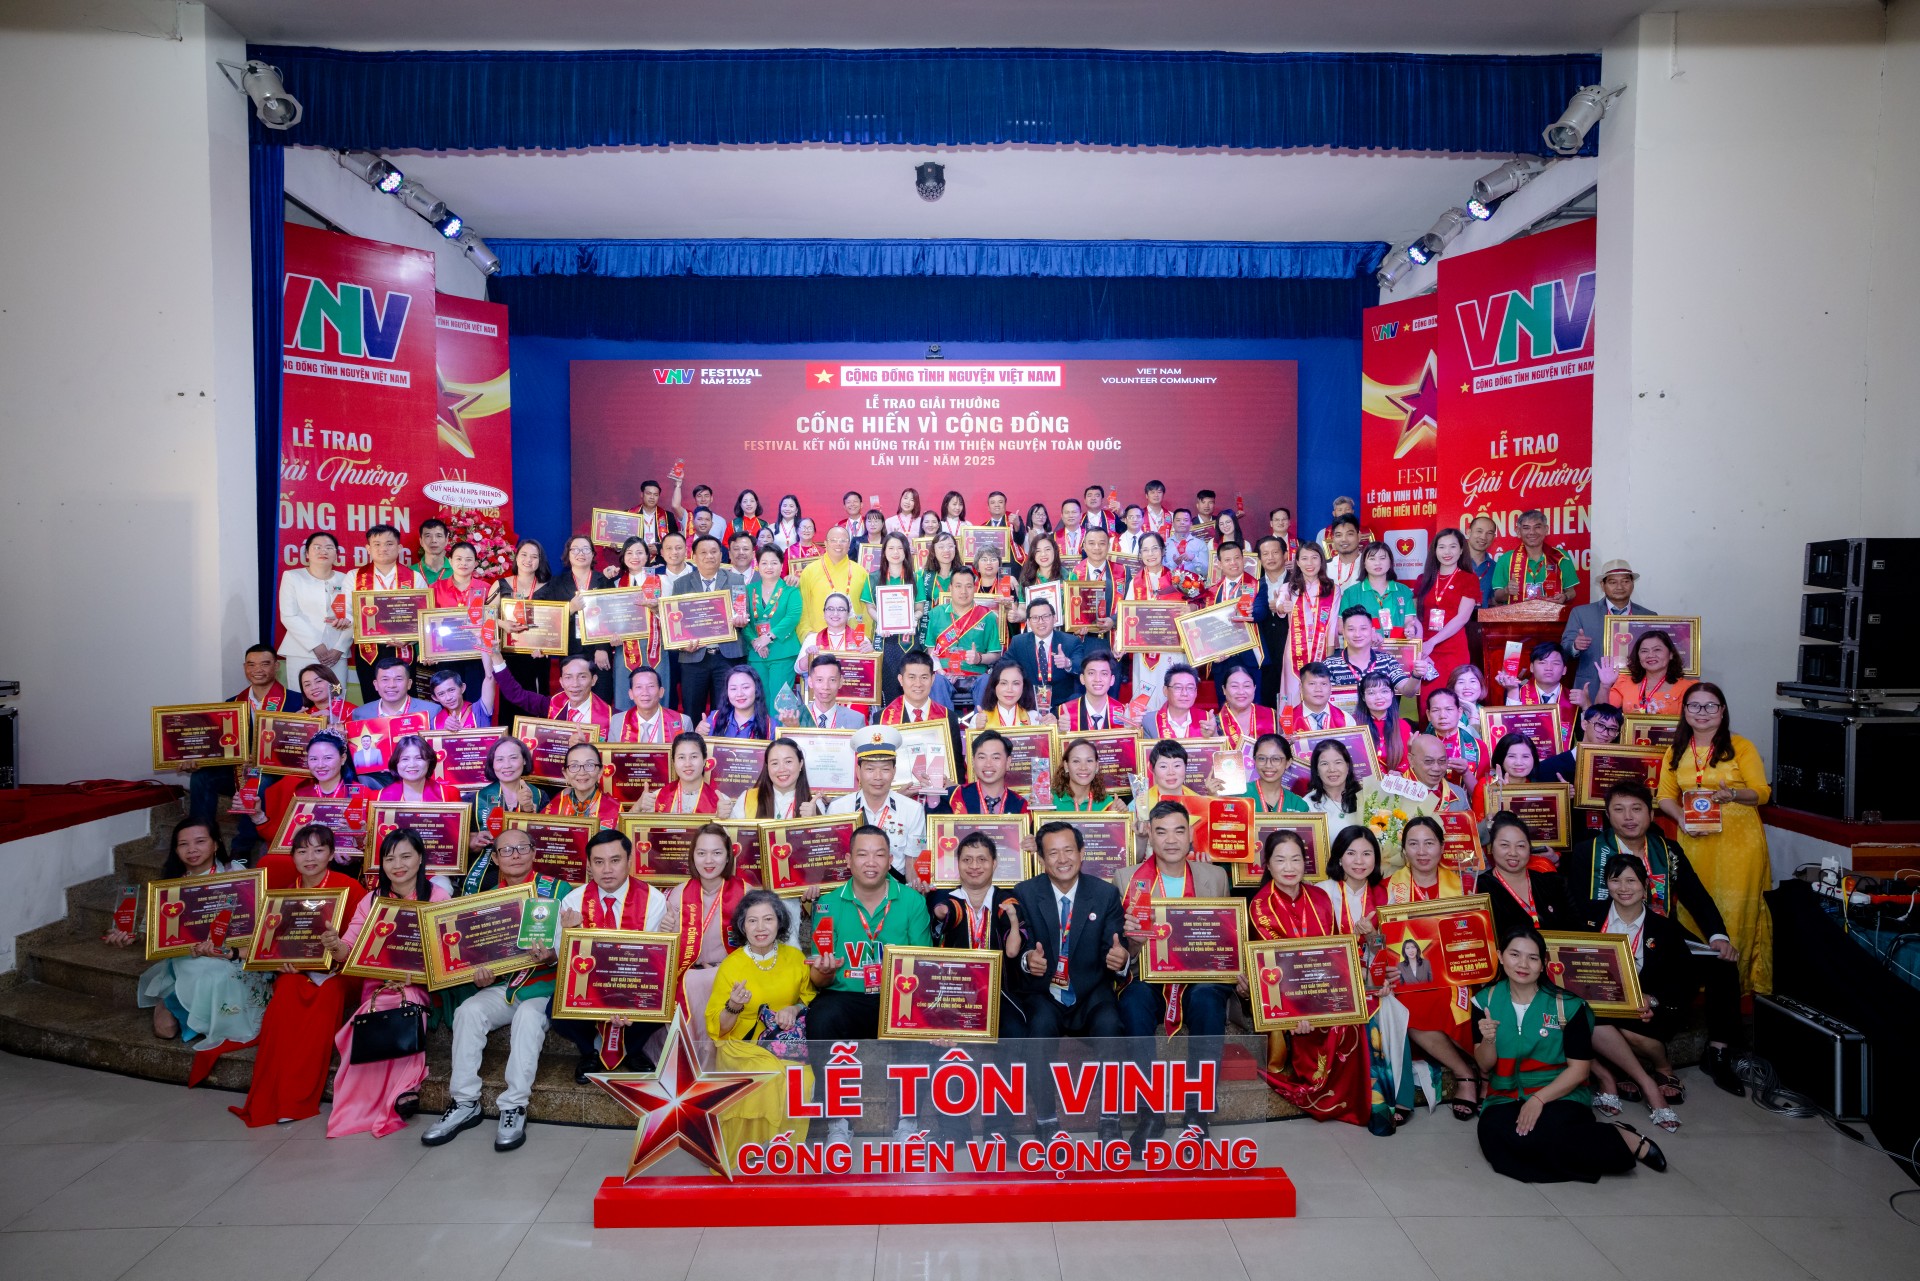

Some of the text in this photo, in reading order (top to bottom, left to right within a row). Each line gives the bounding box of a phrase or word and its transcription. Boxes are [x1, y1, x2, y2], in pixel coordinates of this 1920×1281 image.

[438, 318, 496, 334] TÌNH NGUYỆN VIỆT NAM
[1456, 271, 1595, 370] VNV
[1372, 321, 1399, 341] VNV
[284, 360, 293, 370] NG
[320, 364, 338, 376] TÌNH
[340, 368, 369, 380] NGUYỆN
[372, 370, 387, 384] VIỆT
[390, 374, 408, 384] NAM
[653, 369, 694, 384] VNV
[701, 369, 762, 377] FESTIVAL
[846, 368, 877, 384] CỘNG
[918, 368, 944, 382] TÌNH
[949, 368, 994, 384] NGUYỆN
[1000, 368, 1024, 384] VIỆT
[1028, 370, 1056, 382] NAM
[1476, 362, 1594, 391] CỘNG ĐỒNG TÌNH NGUYỆN VIỆT NAM
[866, 394, 1000, 409] LỄ TRAO GIẢI THƯỞNG
[796, 411, 1069, 437] CỐNG HIẾN VÌ CỘNG ĐỒNG
[292, 418, 372, 452] LỄ TRAO
[744, 437, 1121, 452] FESTIVAL KẾT NỐI NHỮNG TRÁI TIM THIỆN NGUYỆN TOÀN QUỐC
[1491, 430, 1558, 459] LỄ TRAO
[898, 456, 919, 466] VIII
[934, 454, 960, 466] NĂM
[964, 456, 995, 466] 2025
[282, 454, 408, 494] iải Thưởng
[1398, 466, 1437, 484] FESTI
[1461, 458, 1592, 507] Giải Thưởng
[430, 484, 442, 492] QUỸ
[479, 490, 501, 498] FRIENDS
[1367, 490, 1376, 504] LỄ
[1378, 486, 1391, 502] TÔN
[1393, 489, 1410, 501] VINH
[1413, 486, 1423, 500] VÀ
[279, 490, 410, 533] ỐNG HIẾN
[1372, 502, 1437, 518] CỐNG HIẾN VÌ CỘN
[1543, 1013, 1558, 1024] VN
[786, 1043, 1214, 1119] LỄ TÔN VINH
[737, 1124, 1259, 1180] CỐNG HIẾN VÌ CỘNG ĐỒNG
